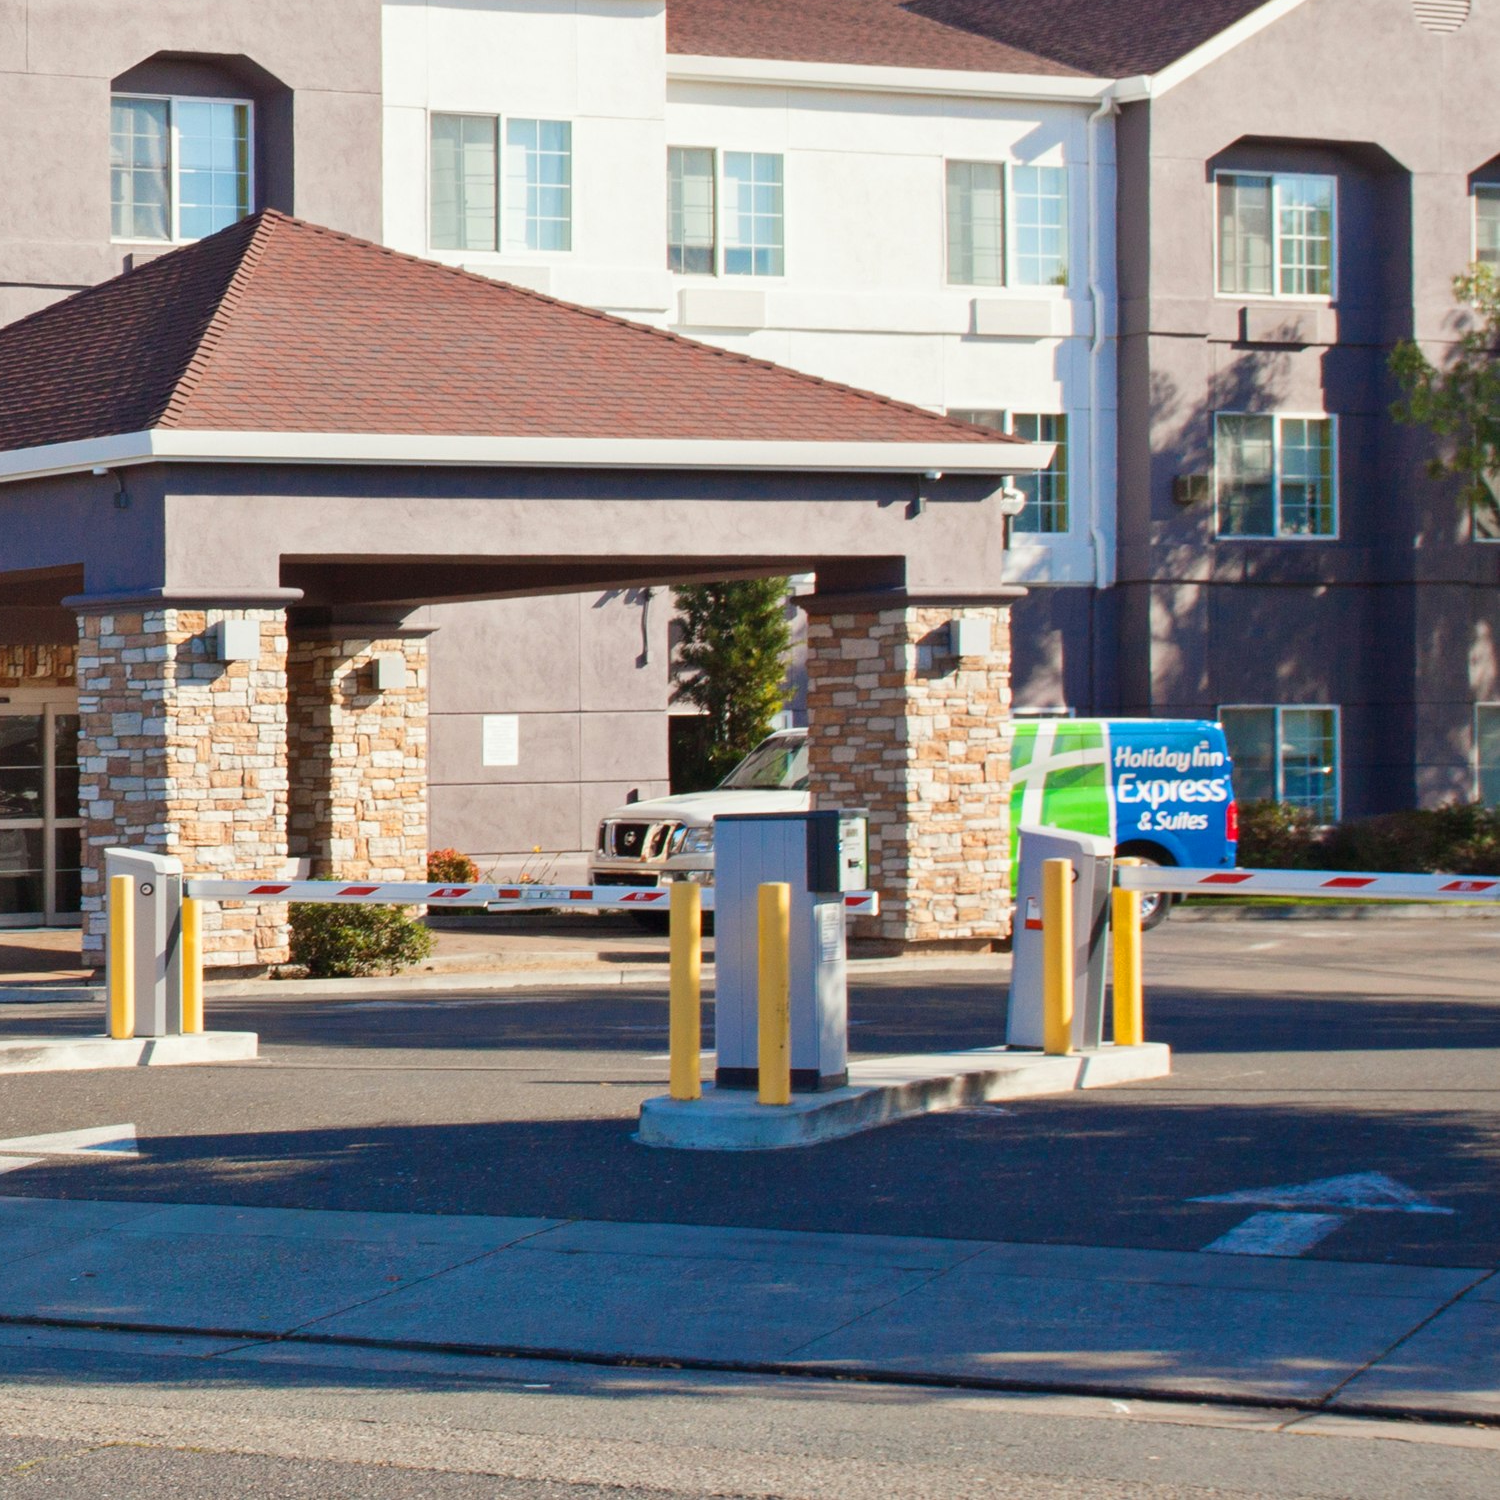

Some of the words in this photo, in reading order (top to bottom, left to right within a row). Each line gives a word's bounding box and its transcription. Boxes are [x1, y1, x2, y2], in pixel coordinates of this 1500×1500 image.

[1114, 745, 1191, 772] Holiday
[1192, 745, 1224, 767] Inn
[1117, 772, 1228, 811] Express
[1137, 811, 1152, 831] &
[1153, 810, 1209, 830] Suites
